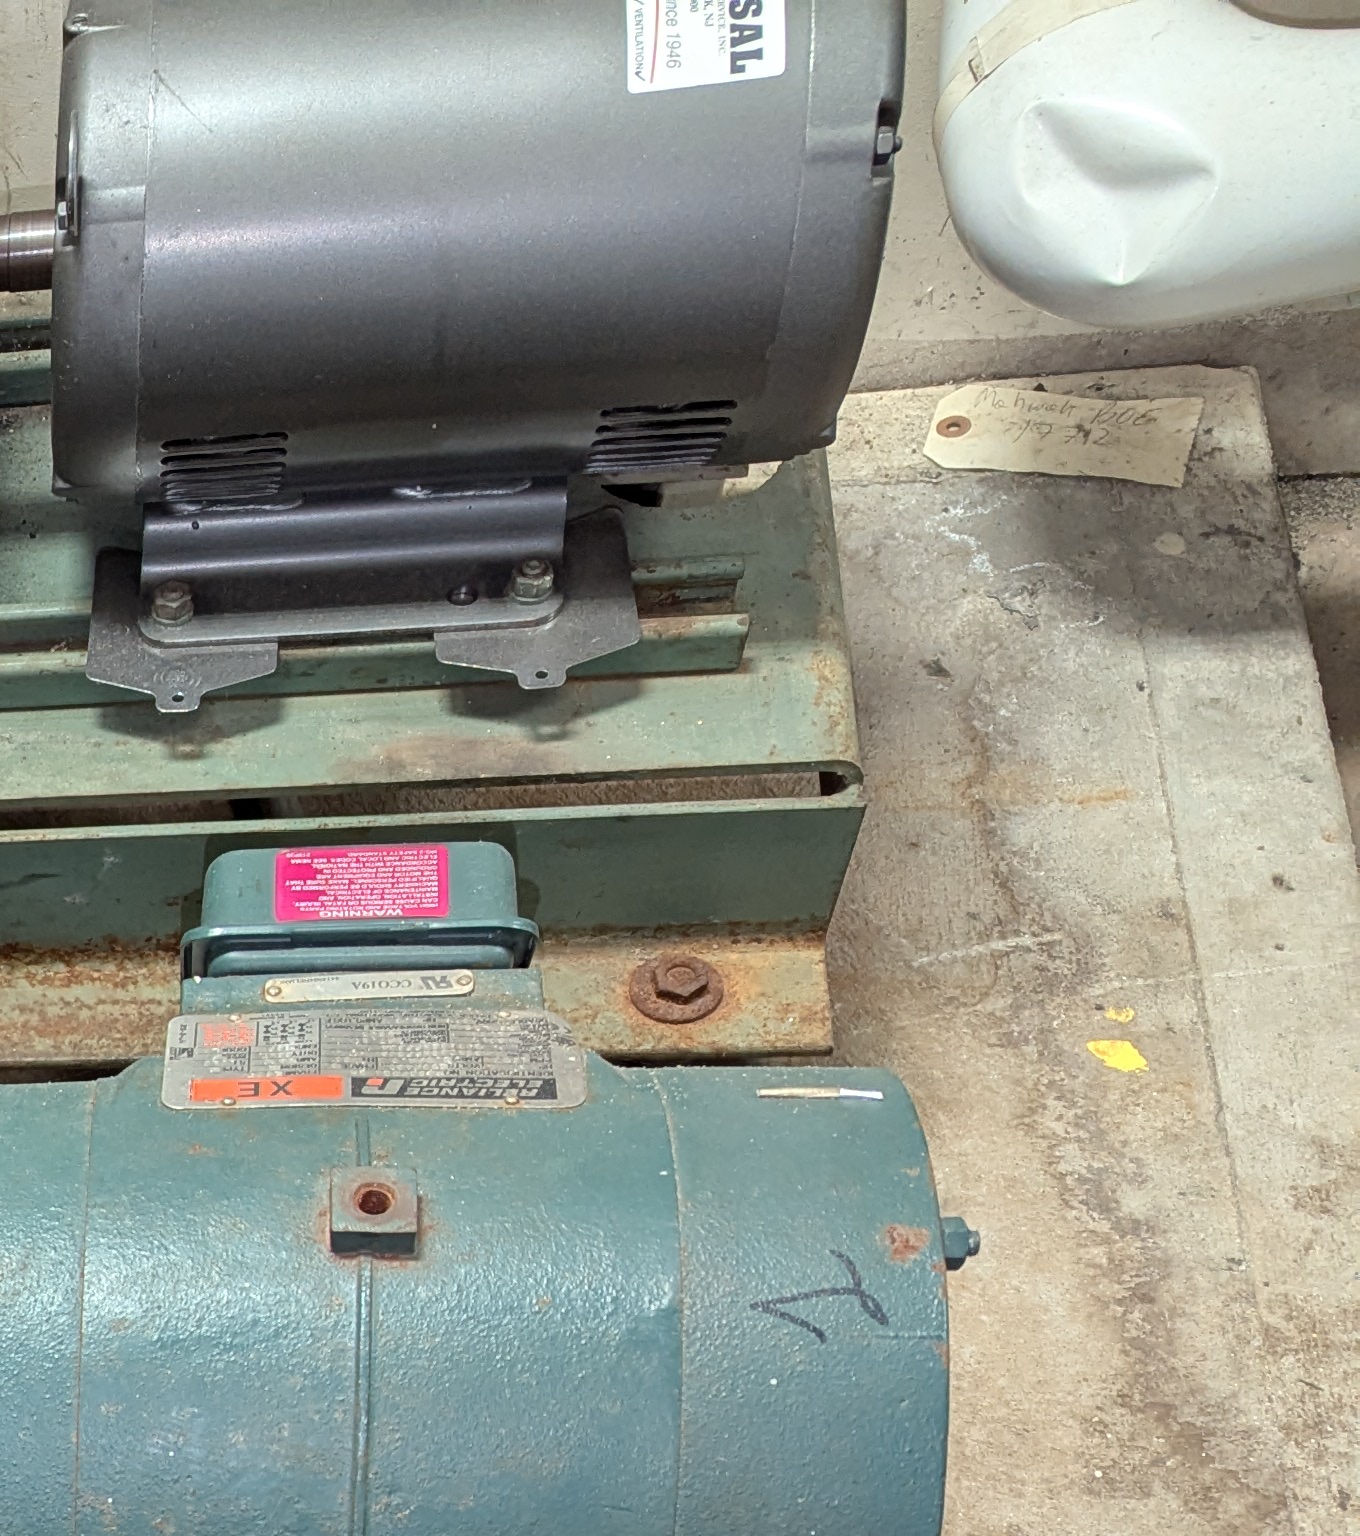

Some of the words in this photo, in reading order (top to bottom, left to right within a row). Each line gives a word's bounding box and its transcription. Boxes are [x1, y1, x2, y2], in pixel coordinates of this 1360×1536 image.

[634, 8, 644, 70] VENTILATION
[666, 32, 681, 69] 1946
[319, 909, 402, 918] WARNING
[408, 1078, 543, 1087] ELECTRIC
